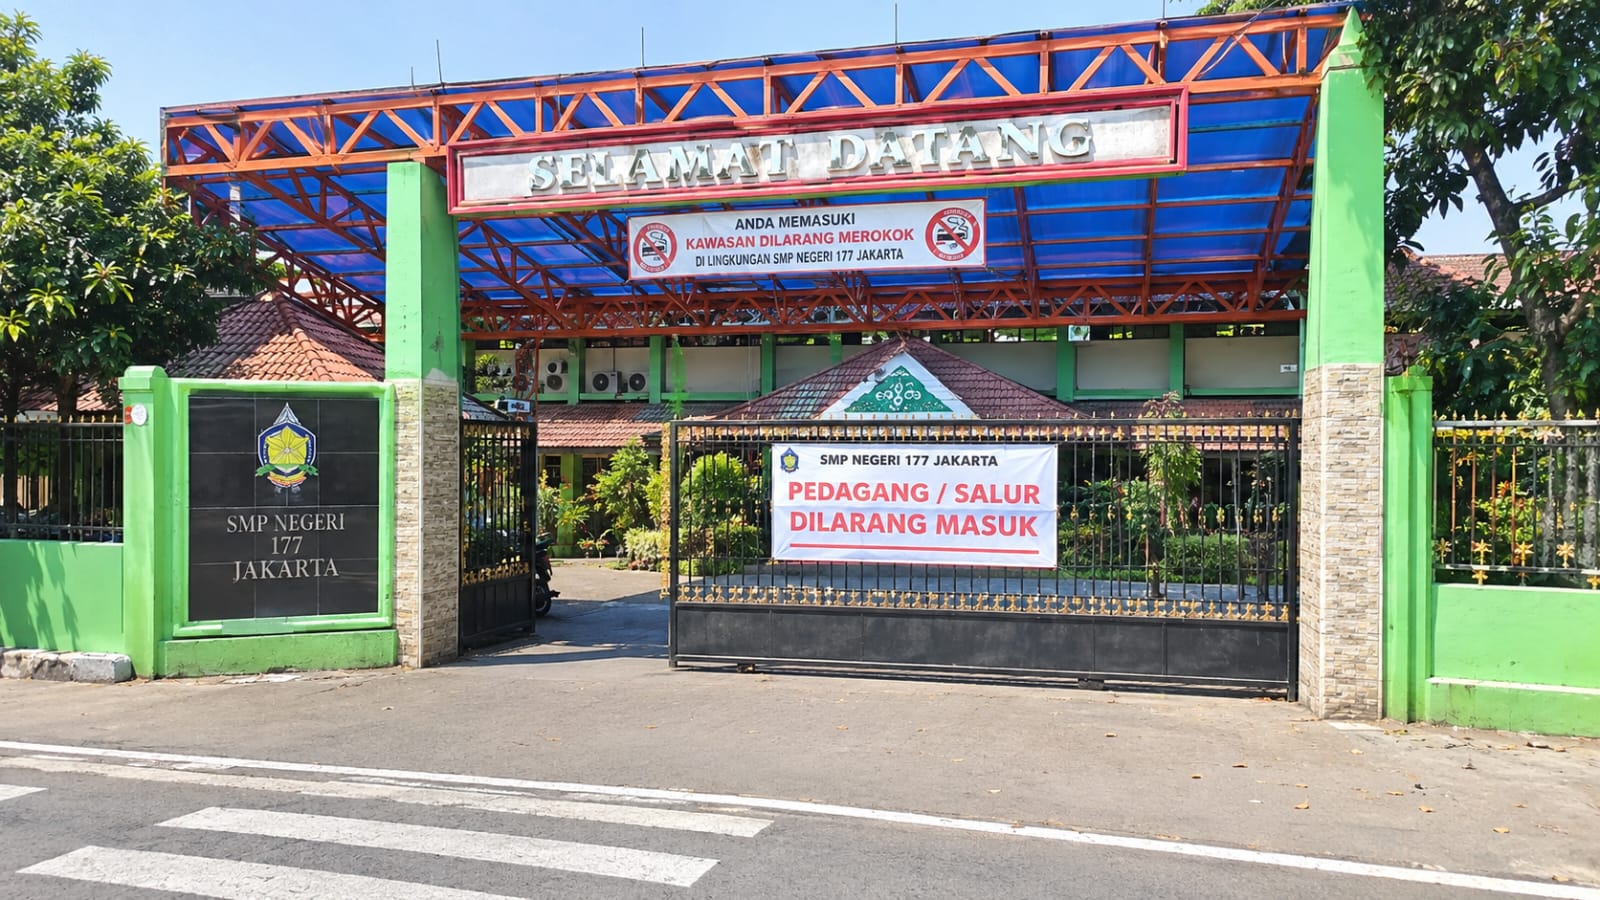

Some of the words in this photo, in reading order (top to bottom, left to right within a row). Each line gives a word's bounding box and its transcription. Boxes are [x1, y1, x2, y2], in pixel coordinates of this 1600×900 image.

[528, 138, 796, 192] SELAMAT
[827, 118, 1093, 173] DATANG
[735, 217, 775, 231] ANDA
[779, 213, 856, 228] MEMASUKI
[686, 235, 756, 250] KAWASAN
[760, 231, 835, 247] DILARANG
[839, 228, 915, 243] MEROKOK
[695, 255, 705, 267] DI
[708, 252, 771, 267] LINGKUNGAN
[773, 252, 794, 265] SMP
[796, 251, 833, 263] NEGERI
[836, 250, 854, 262] 177
[857, 248, 904, 261] JAKARTA
[820, 454, 849, 466] SMP
[852, 454, 901, 466] NEGERI
[905, 455, 930, 466] 177
[933, 455, 999, 467] JAKARTA
[788, 481, 930, 503] PEDAGANG
[936, 483, 948, 505] /
[955, 483, 1041, 505] SALUR
[226, 514, 268, 533] SMP
[274, 512, 345, 532] NEGERI
[790, 511, 927, 535] DILARANG
[936, 514, 1039, 537] MASUK
[271, 535, 303, 555] 177
[232, 557, 340, 584] JAKARTA
